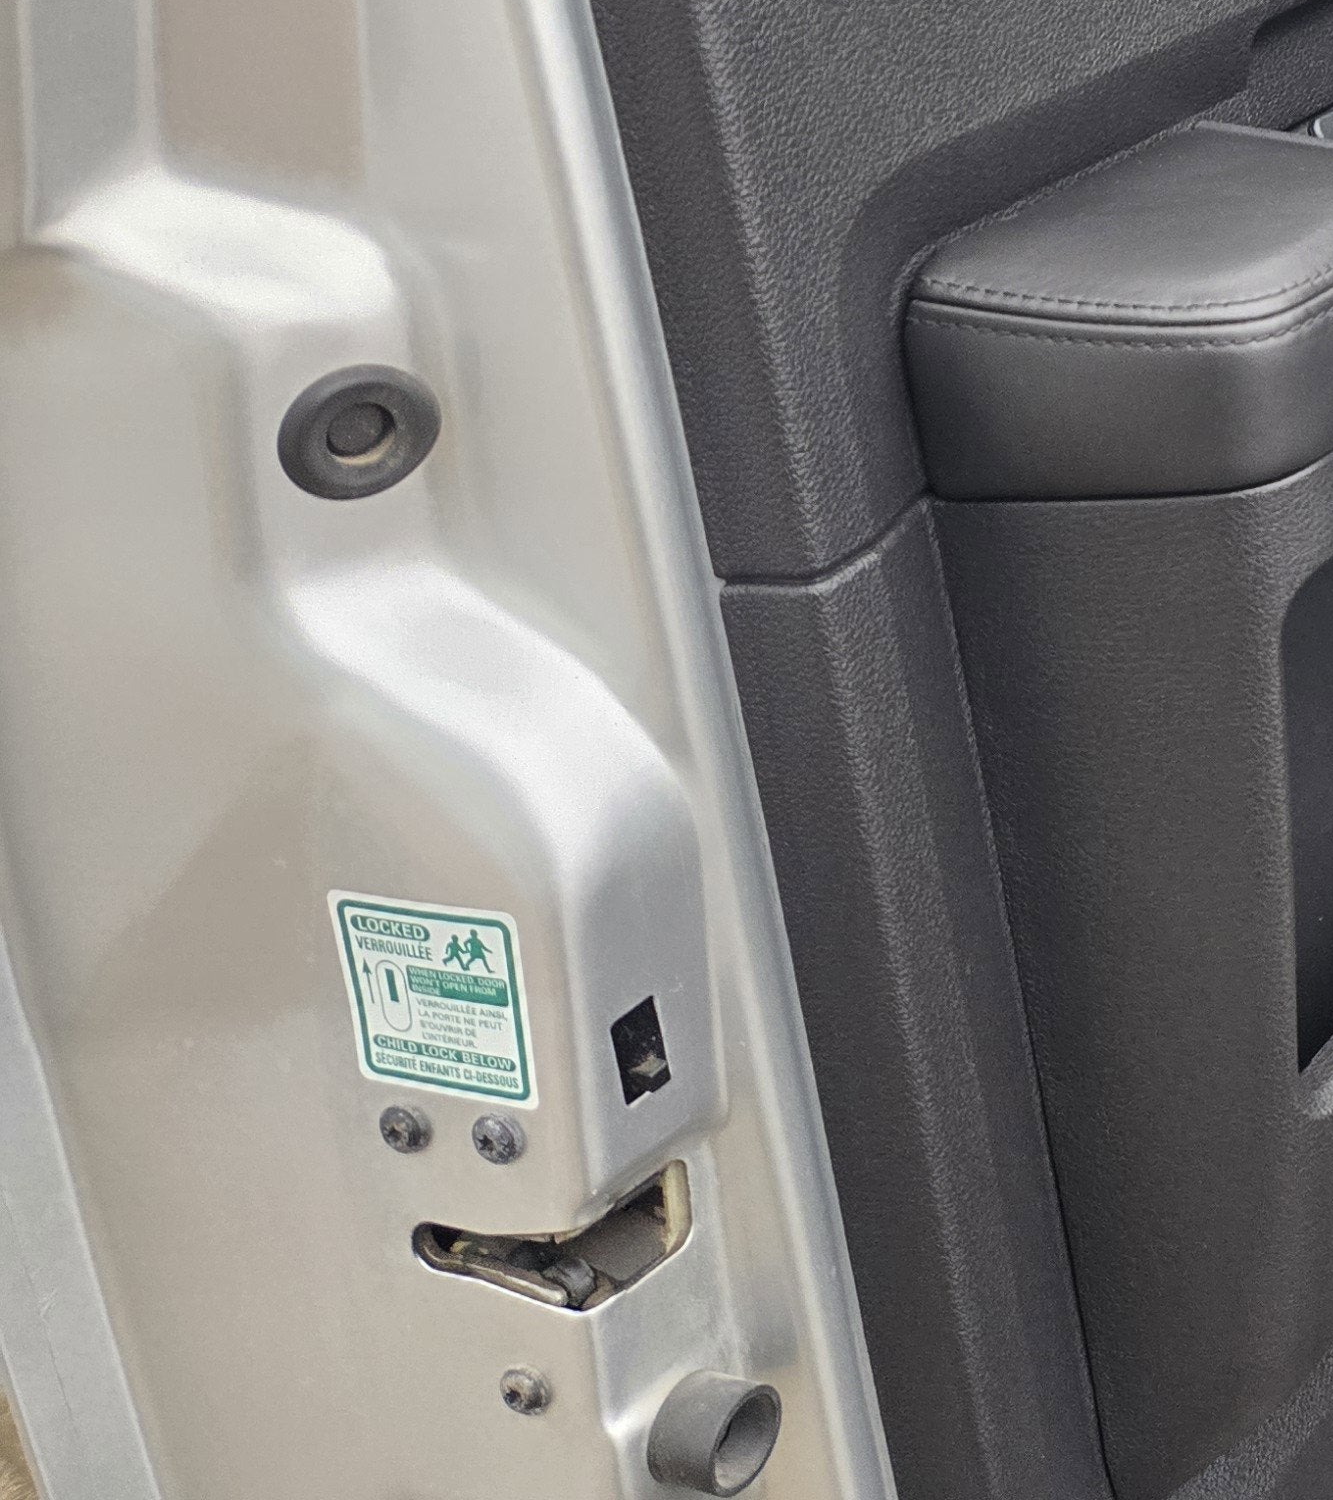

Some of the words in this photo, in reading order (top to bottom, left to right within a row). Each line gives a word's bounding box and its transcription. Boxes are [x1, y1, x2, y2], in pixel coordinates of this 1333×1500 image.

[357, 916, 425, 939] LOCKED
[355, 934, 433, 961] VERROUILLÉE
[408, 966, 437, 979] WHEN
[477, 978, 505, 988] DOOR
[442, 981, 467, 992] OPEN
[469, 985, 496, 996] FROM
[418, 1009, 430, 1018] LA
[432, 1010, 461, 1024] PORTE
[464, 1017, 475, 1027] NE
[479, 1019, 502, 1031] PEUT
[377, 1035, 417, 1053] CHILD
[422, 1044, 458, 1062] LOCK
[462, 1051, 511, 1070] BELOW
[375, 1050, 417, 1069] SÉCURITÉ
[420, 1061, 461, 1079] ENFANTS
[463, 1069, 519, 1089] CI-DESSOUS
